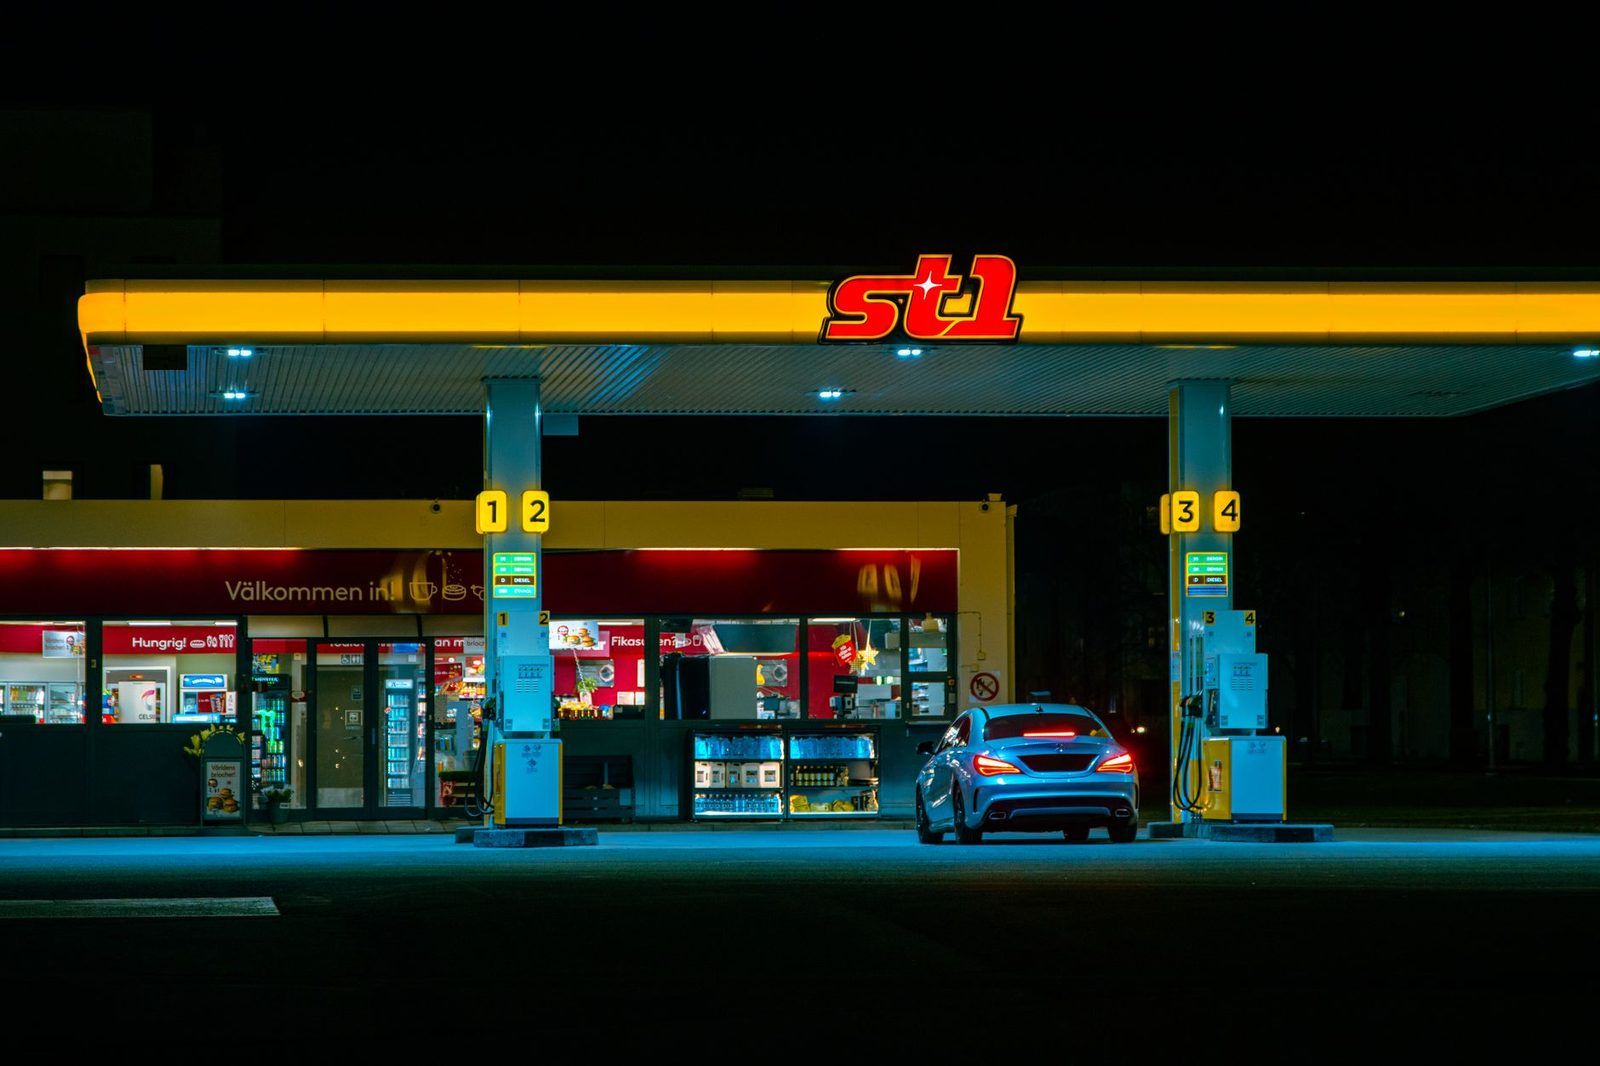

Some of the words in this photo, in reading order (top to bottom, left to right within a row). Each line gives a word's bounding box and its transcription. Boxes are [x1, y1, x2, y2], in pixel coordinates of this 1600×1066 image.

[825, 253, 1020, 339] st1
[487, 500, 497, 523] 1
[530, 500, 546, 523] 2
[1178, 500, 1194, 523] 3
[1221, 499, 1238, 522] 4
[225, 580, 362, 601] Välkommen
[369, 580, 395, 601] in!
[500, 613, 506, 626] 1
[539, 613, 548, 625] 2
[1205, 611, 1215, 624] 3
[1245, 612, 1254, 624] 4
[132, 636, 187, 651] Hungrig!
